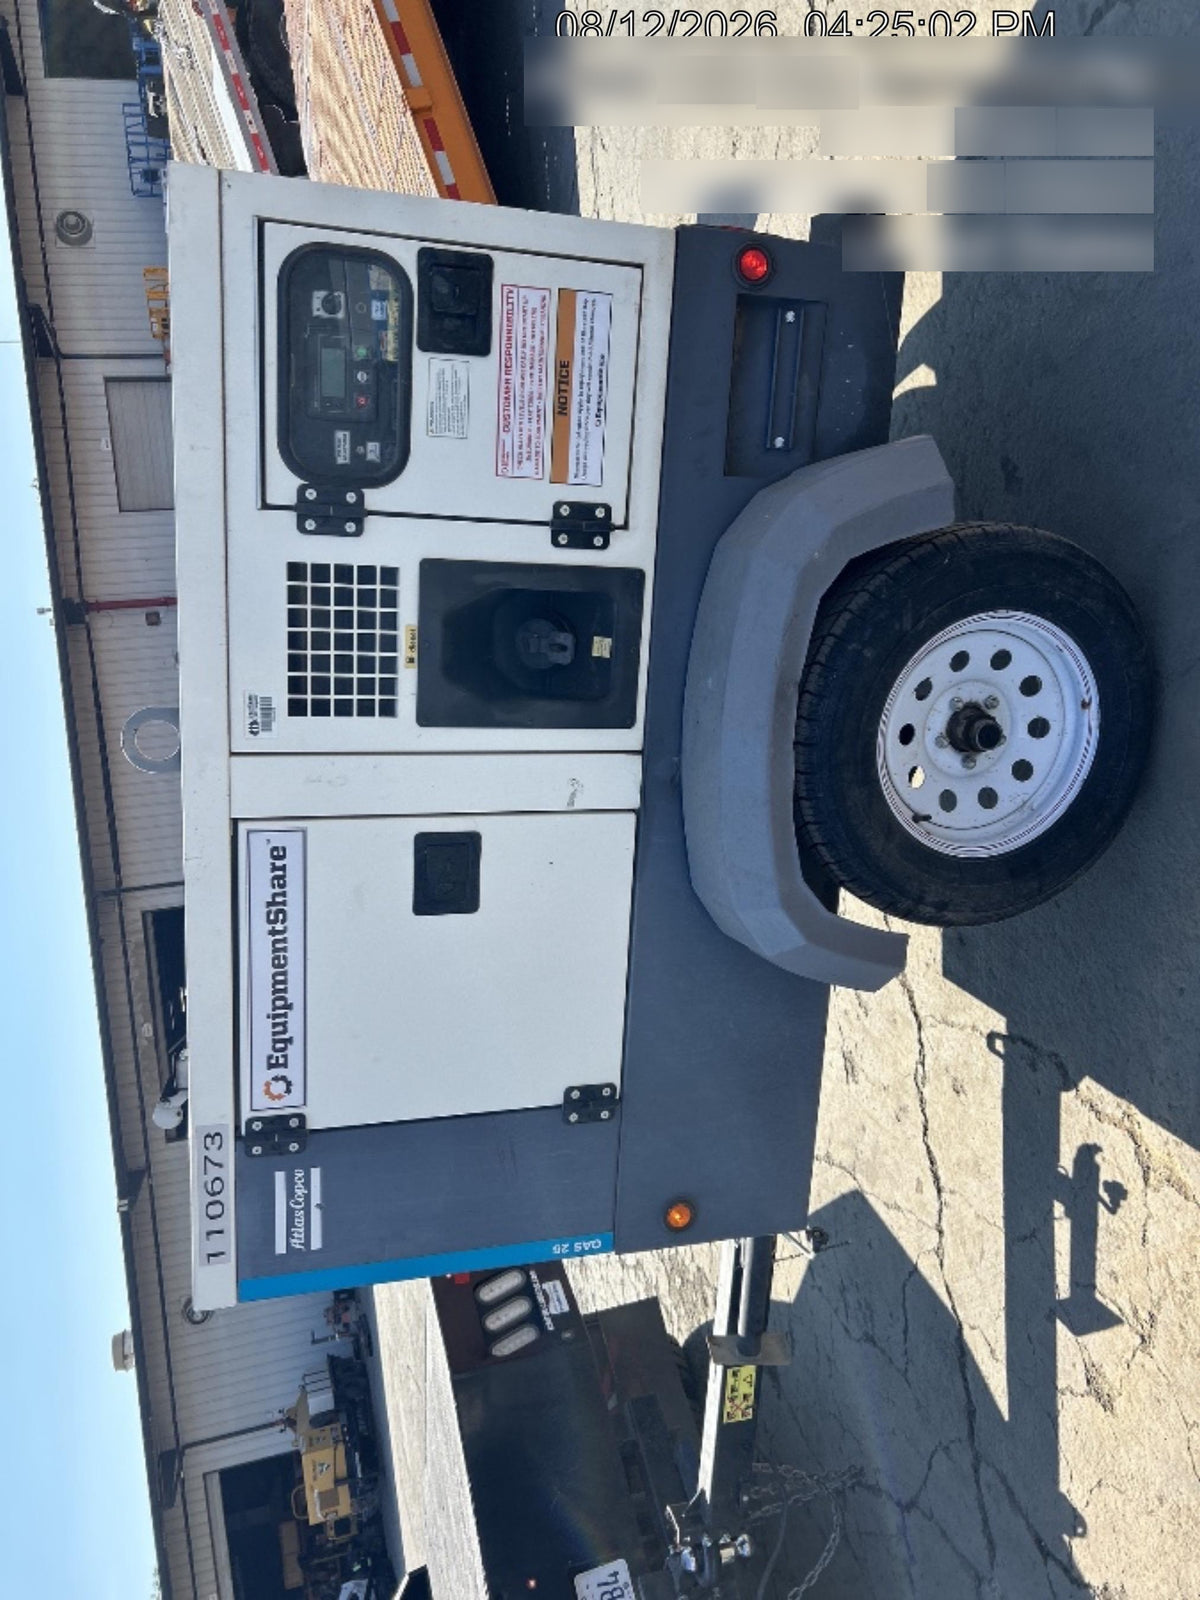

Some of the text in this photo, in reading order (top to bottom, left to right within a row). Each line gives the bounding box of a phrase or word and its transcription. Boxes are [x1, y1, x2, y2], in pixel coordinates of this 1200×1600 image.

[556, 360, 570, 416] NOTICE
[266, 845, 293, 1070] EquipmentShare
[203, 1131, 226, 1264] 110673
[288, 1169, 308, 1251] Atlas Copco
[573, 1239, 602, 1252] QAS
